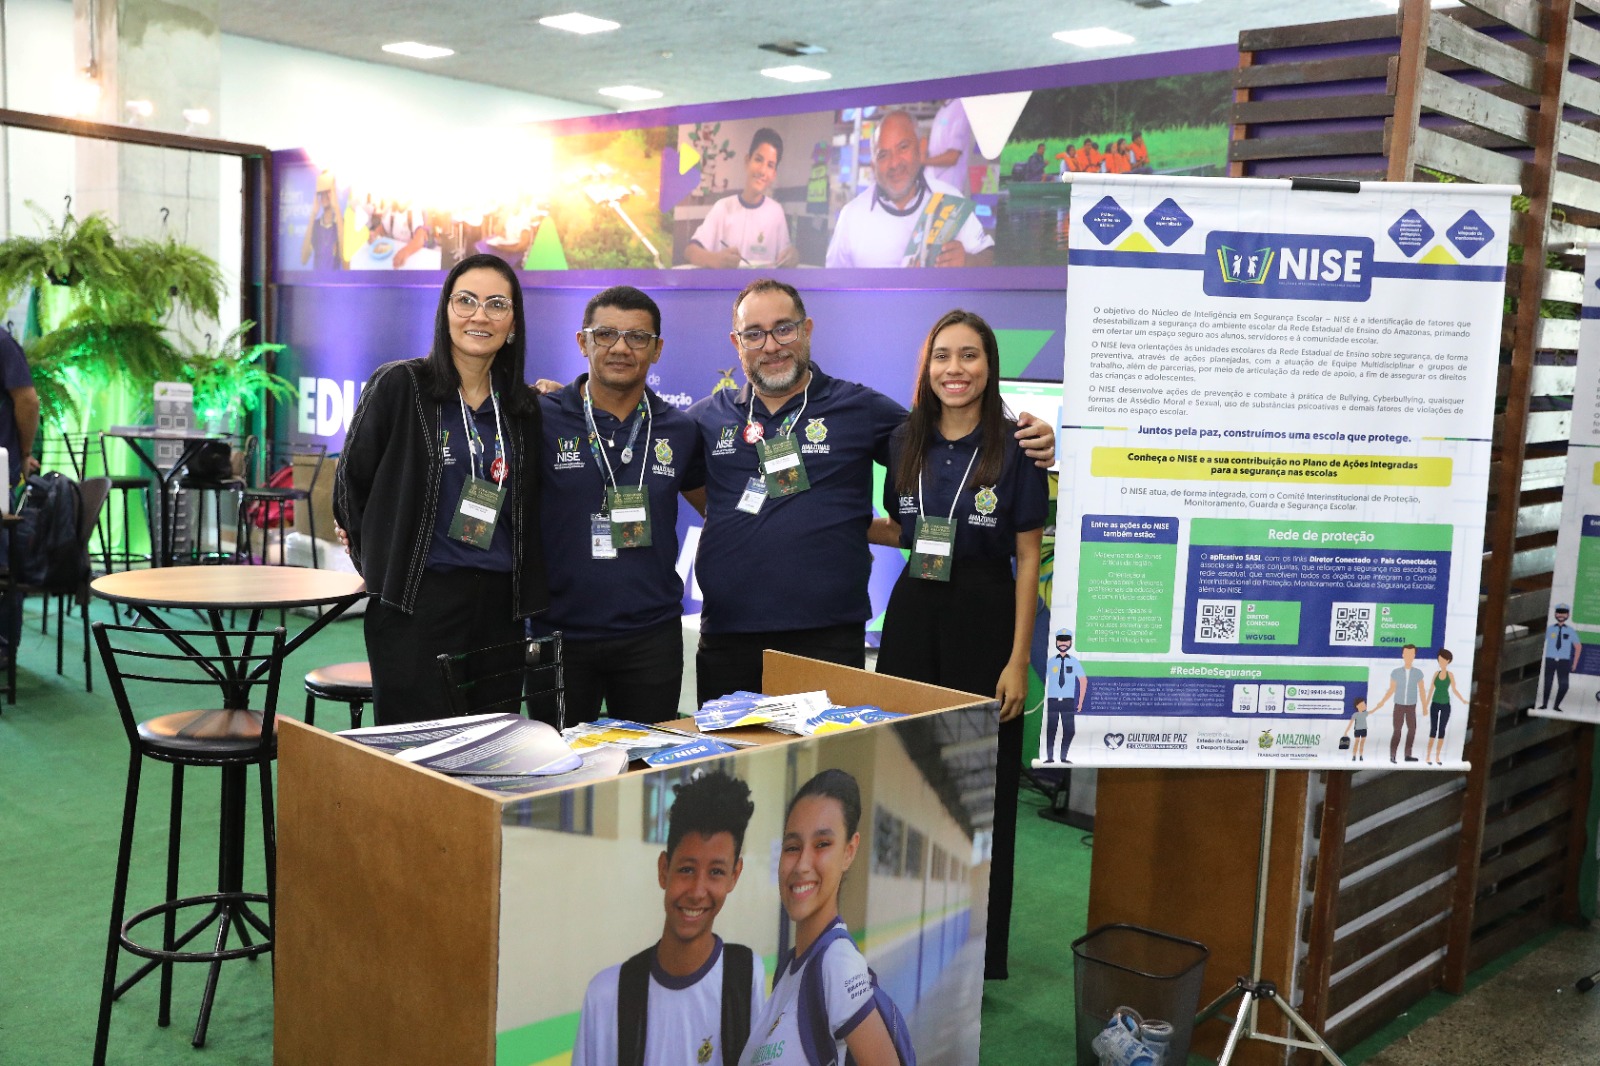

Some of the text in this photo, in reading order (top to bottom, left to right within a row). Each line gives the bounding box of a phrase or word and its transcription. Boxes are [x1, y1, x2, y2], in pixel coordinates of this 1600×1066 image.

[1278, 248, 1363, 282] NISE
[1193, 310, 1236, 319] Inteligência
[1253, 312, 1293, 321] Segurança
[1367, 317, 1413, 325] identificação
[648, 373, 660, 386] de
[1137, 425, 1172, 434] Juntos
[1174, 427, 1197, 437] pela
[1199, 429, 1221, 438] paz,
[1223, 429, 1286, 438] construímos
[1312, 431, 1345, 440] escola
[1346, 434, 1366, 442] que
[1367, 434, 1411, 443] protege.
[716, 439, 735, 449] NISE
[557, 452, 580, 463] NISE
[1127, 452, 1167, 463] Conheça
[1177, 454, 1197, 462] NISE
[1230, 457, 1287, 466] contribuição
[1302, 458, 1328, 468] Plano
[1342, 459, 1368, 469] Ações
[1369, 460, 1417, 469] Integradas
[1239, 468, 1286, 476] segurança
[1120, 486, 1127, 494] O
[1182, 489, 1207, 497] forma
[1208, 490, 1247, 499] integrada,
[1276, 492, 1304, 500] Comitê
[1306, 493, 1369, 502] Interinstitucional
[1383, 494, 1420, 503] Proteção,
[1183, 498, 1247, 507] Monitoramento,
[1287, 501, 1327, 510] Segurança
[968, 514, 997, 523] AMAZONAS
[1268, 528, 1374, 543] Rede de proteção
[1170, 666, 1261, 678] #RedeDeSegurança
[1127, 733, 1187, 742] CULTURA DE PAZ
[1275, 733, 1320, 745] AMAZONAS
[676, 745, 708, 758] NISE
